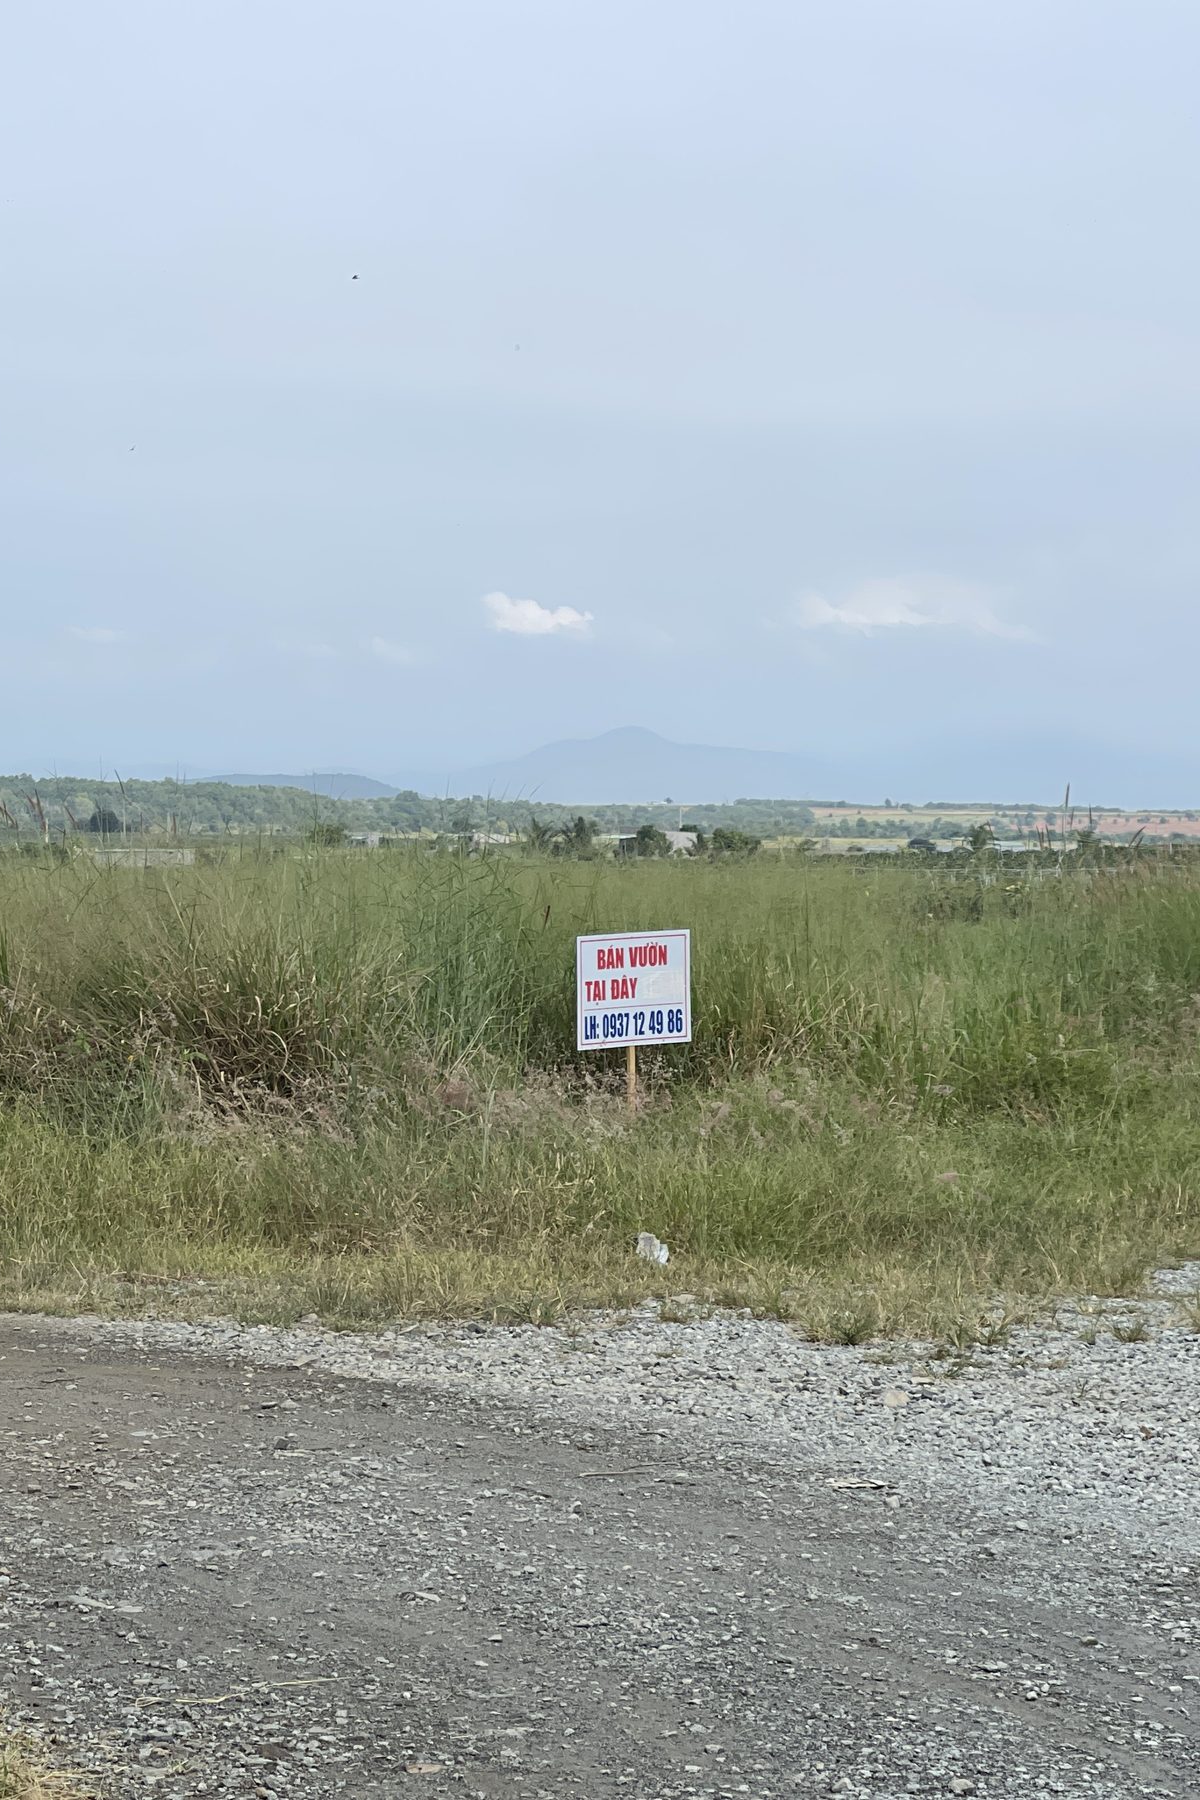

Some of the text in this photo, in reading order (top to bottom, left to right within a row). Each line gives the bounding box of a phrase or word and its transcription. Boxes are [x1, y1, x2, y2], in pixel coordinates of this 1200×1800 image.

[597, 942, 667, 970] BÁN VƯỜN
[585, 975, 638, 1005] TẠI ĐÂY
[584, 1008, 683, 1040] LH: 0937 12 49 86
